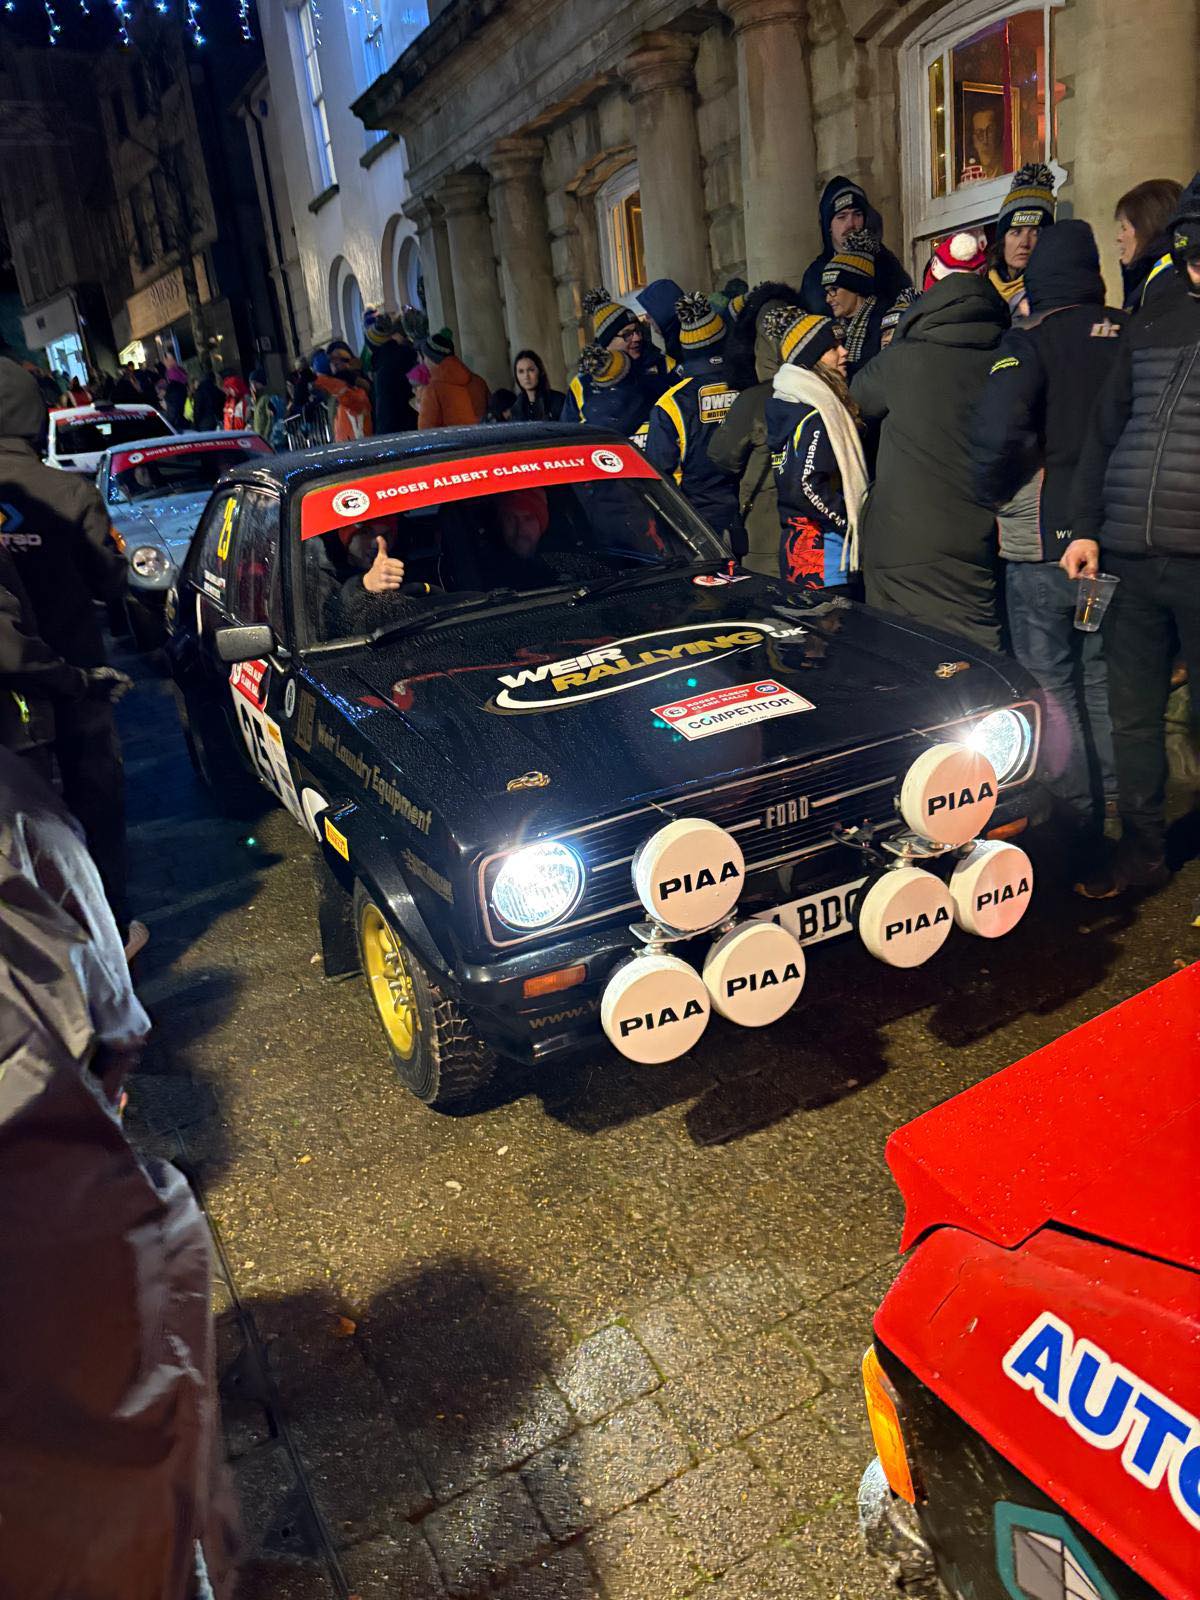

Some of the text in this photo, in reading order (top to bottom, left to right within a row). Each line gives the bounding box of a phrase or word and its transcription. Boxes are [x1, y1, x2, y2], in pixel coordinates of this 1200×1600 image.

[376, 480, 430, 501] ROGER
[432, 469, 489, 490] ALBERT
[492, 462, 541, 479] CLARK
[543, 456, 587, 471] RALLY
[768, 625, 808, 640] UK
[496, 647, 626, 689] WEIR
[551, 630, 766, 693] RALLYING
[686, 687, 751, 708] ROGER ALBERT
[687, 697, 795, 730] COMPETITOR
[690, 691, 749, 712] CLARK RALLY
[239, 703, 284, 798] 25
[335, 734, 373, 790] Laundry
[371, 764, 433, 836] Equipment
[927, 781, 995, 817] PIAA
[765, 796, 810, 829] FORD
[658, 859, 742, 901] PIAA
[975, 876, 1031, 912] PIAA
[884, 905, 951, 942] PIAA
[726, 961, 802, 998] PIAA
[618, 998, 705, 1038] PIAA
